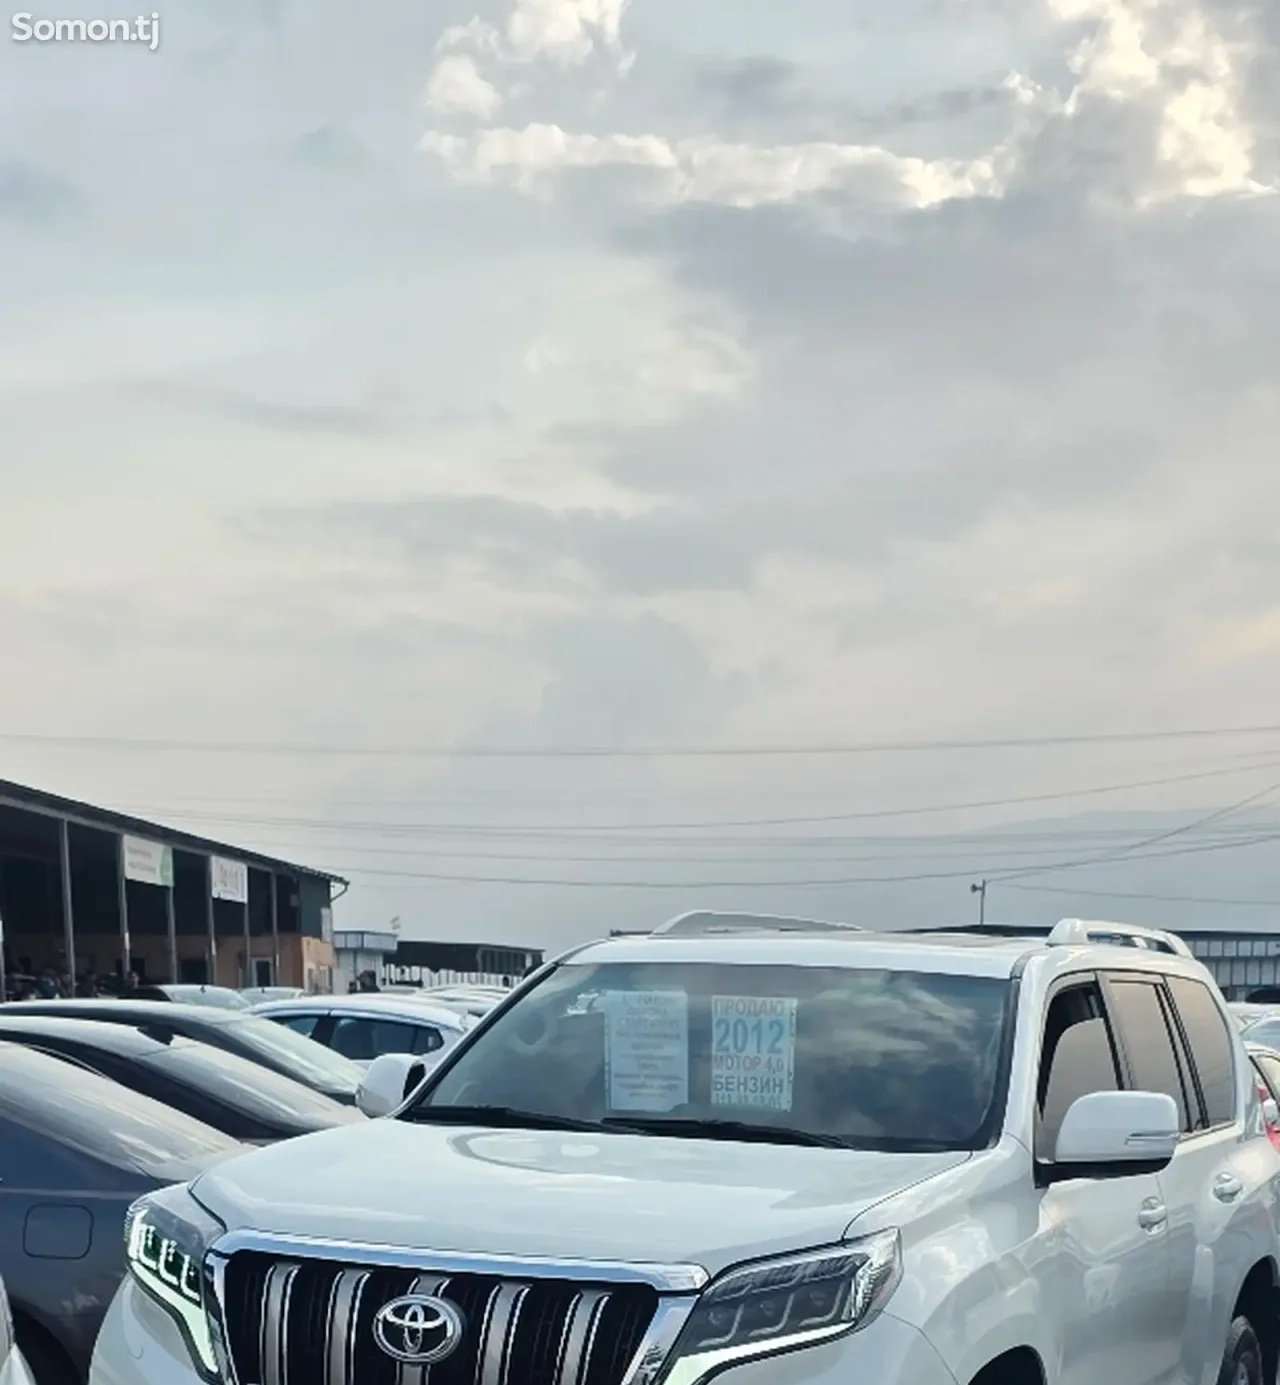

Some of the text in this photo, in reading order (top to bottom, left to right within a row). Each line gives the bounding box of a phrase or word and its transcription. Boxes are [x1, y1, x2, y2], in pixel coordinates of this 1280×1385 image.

[714, 998, 785, 1017] ПРОДАЮ
[714, 1017, 784, 1054] 2012
[714, 1054, 785, 1075] МОТОР 4,0
[713, 1074, 784, 1094] БЕНЗИН
